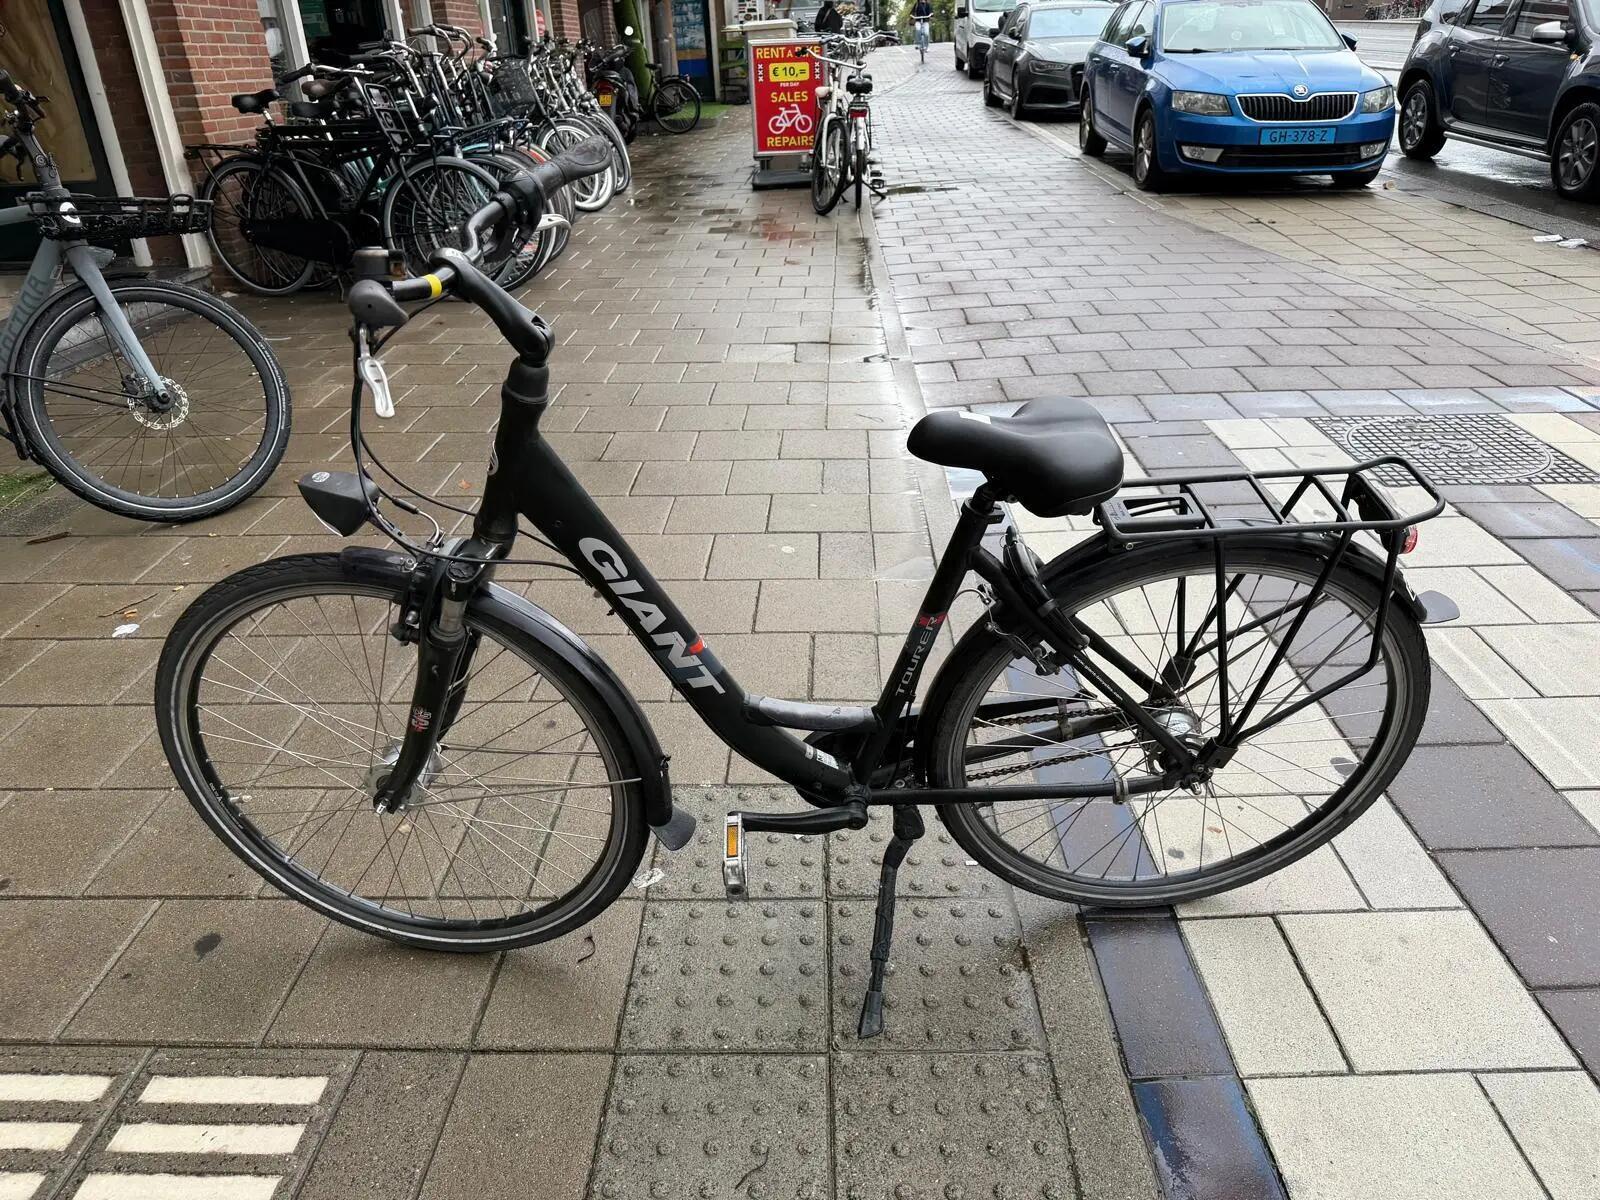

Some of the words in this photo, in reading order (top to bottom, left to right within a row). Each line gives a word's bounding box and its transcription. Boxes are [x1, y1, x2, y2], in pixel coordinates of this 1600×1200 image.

[756, 47, 786, 59] RENT
[787, 49, 794, 58] A
[773, 67, 779, 77] €
[771, 92, 808, 103] SALES
[767, 136, 814, 147] REPAIRS
[1269, 130, 1328, 142] GH-378-Z
[579, 537, 726, 694] GIANT
[895, 616, 938, 697] TOURER
